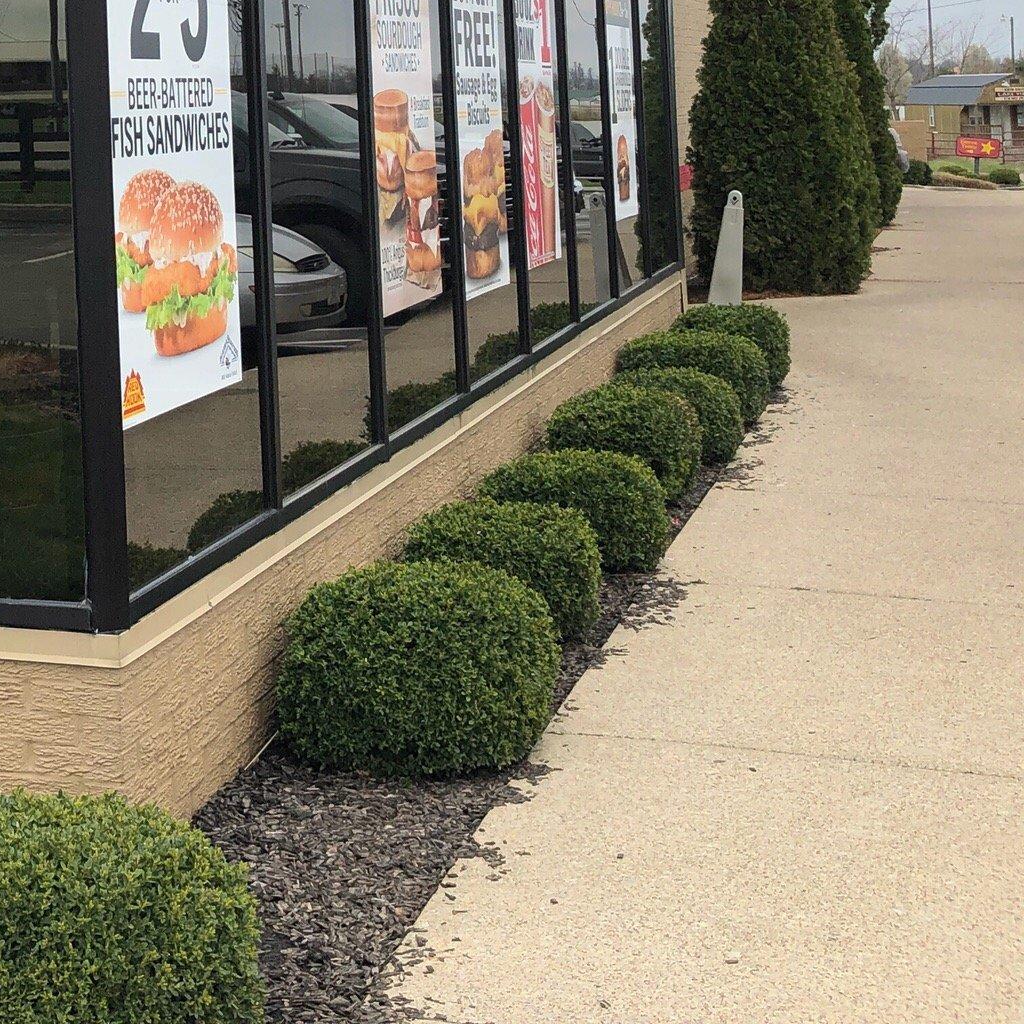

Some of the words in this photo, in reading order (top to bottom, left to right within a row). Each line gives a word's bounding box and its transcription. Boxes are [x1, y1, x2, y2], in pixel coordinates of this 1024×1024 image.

[377, 20, 422, 49] SOURDOUGH
[454, 9, 496, 68] FREE!
[384, 53, 417, 72] SANDWICHES
[127, 77, 214, 111] BEER-BATTERED
[456, 72, 481, 103] Sausage
[482, 73, 487, 95] &
[487, 72, 498, 102] Egg
[467, 101, 490, 125] Biscuits
[111, 115, 144, 159] FISH
[147, 111, 230, 157] SANDWICHES
